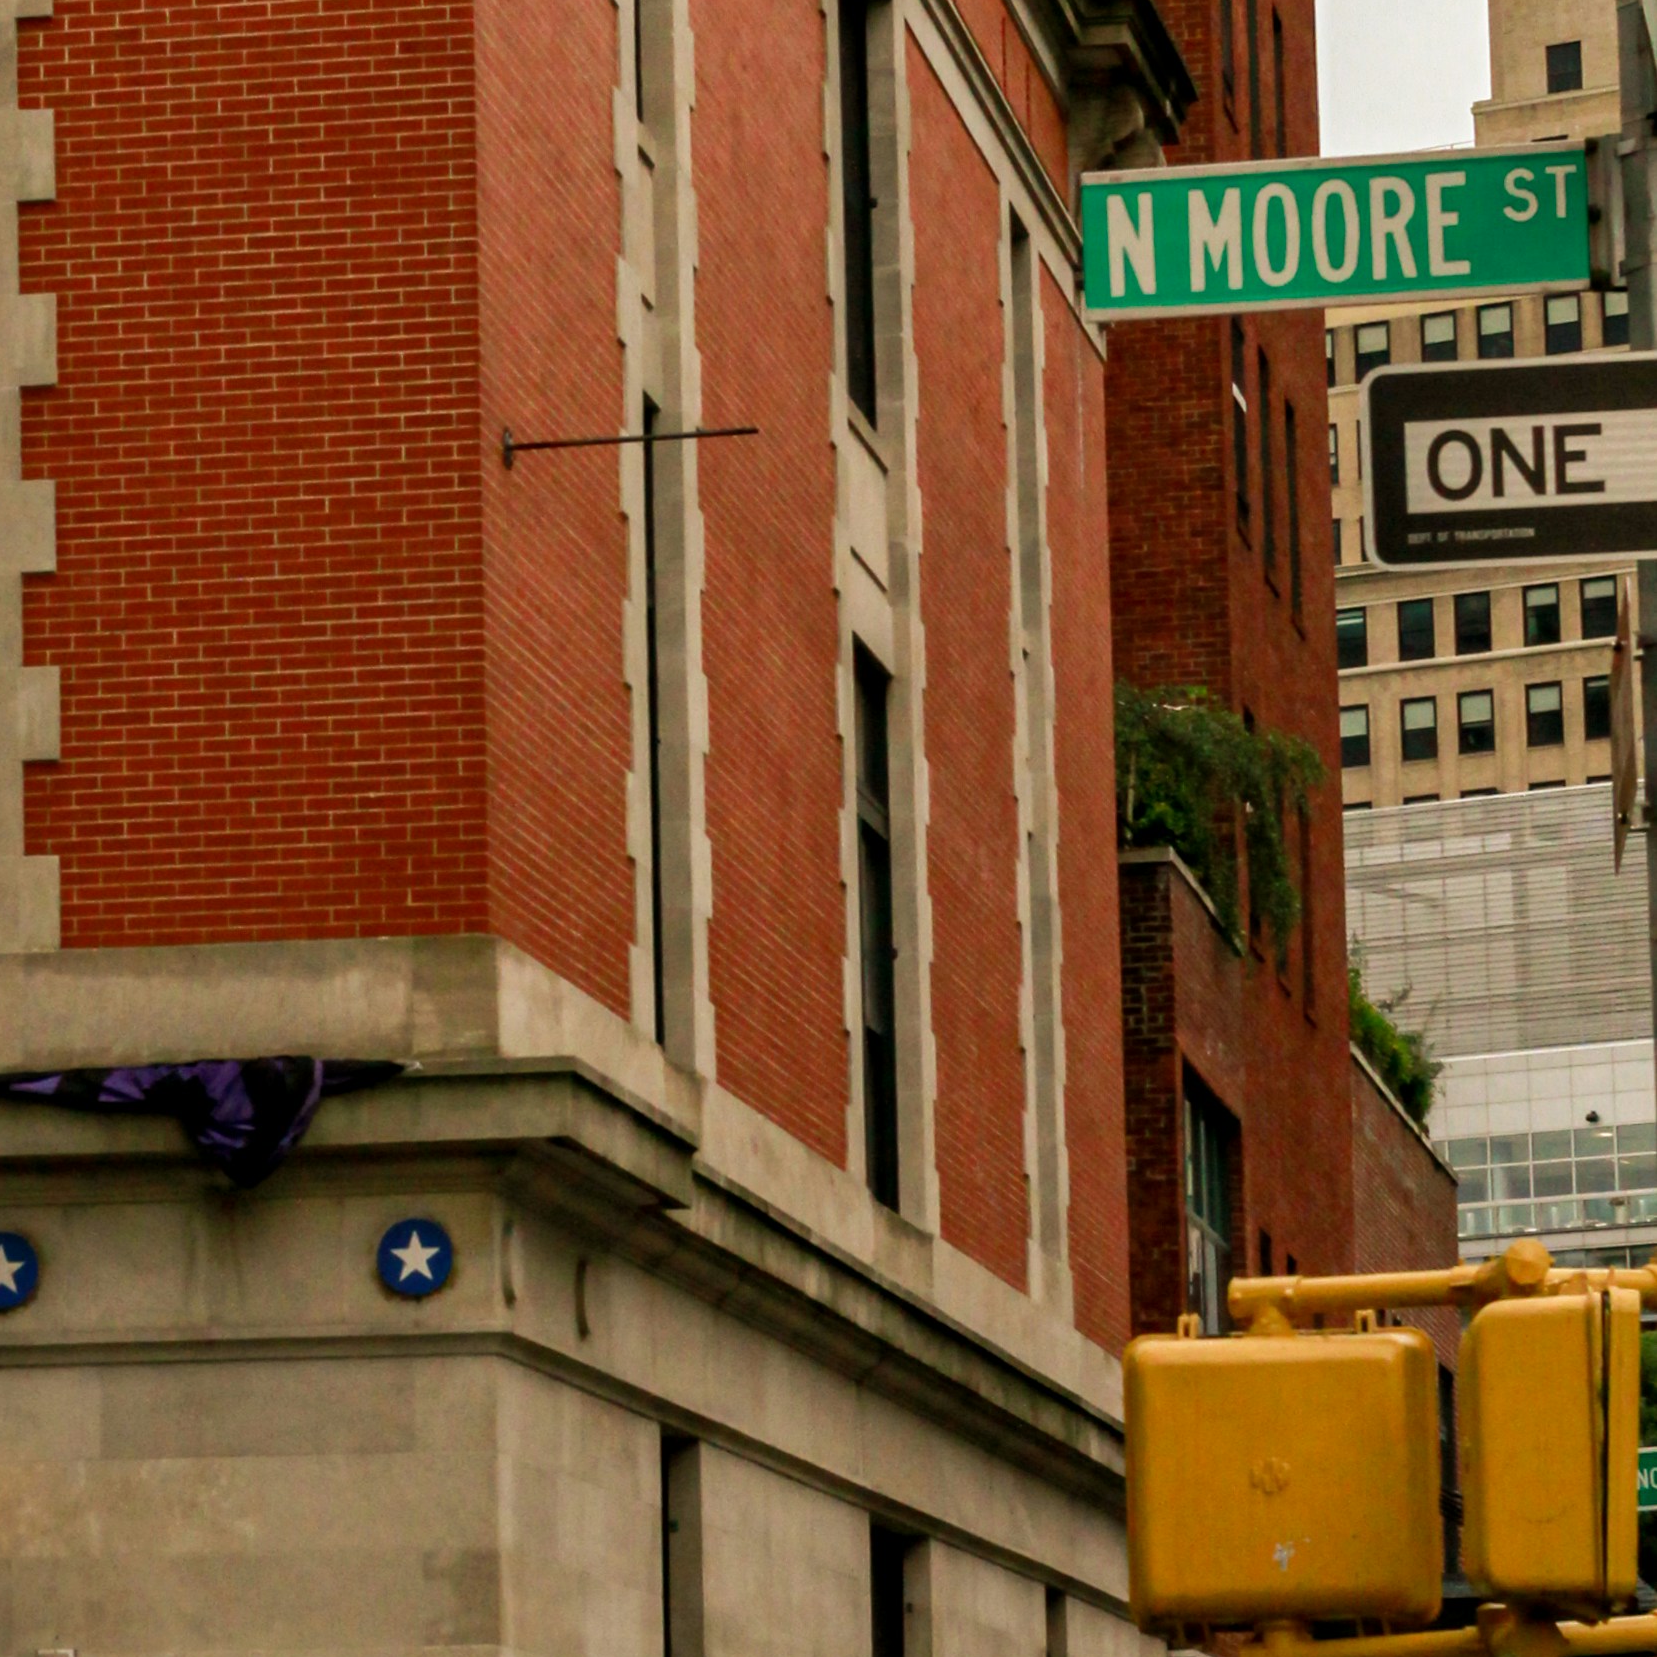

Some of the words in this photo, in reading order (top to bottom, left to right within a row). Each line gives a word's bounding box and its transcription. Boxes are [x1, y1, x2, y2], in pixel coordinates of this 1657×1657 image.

[1105, 192, 1157, 298] N
[1187, 171, 1472, 293] MOORE
[1502, 164, 1577, 223] ST
[1426, 422, 1607, 502] ONE
